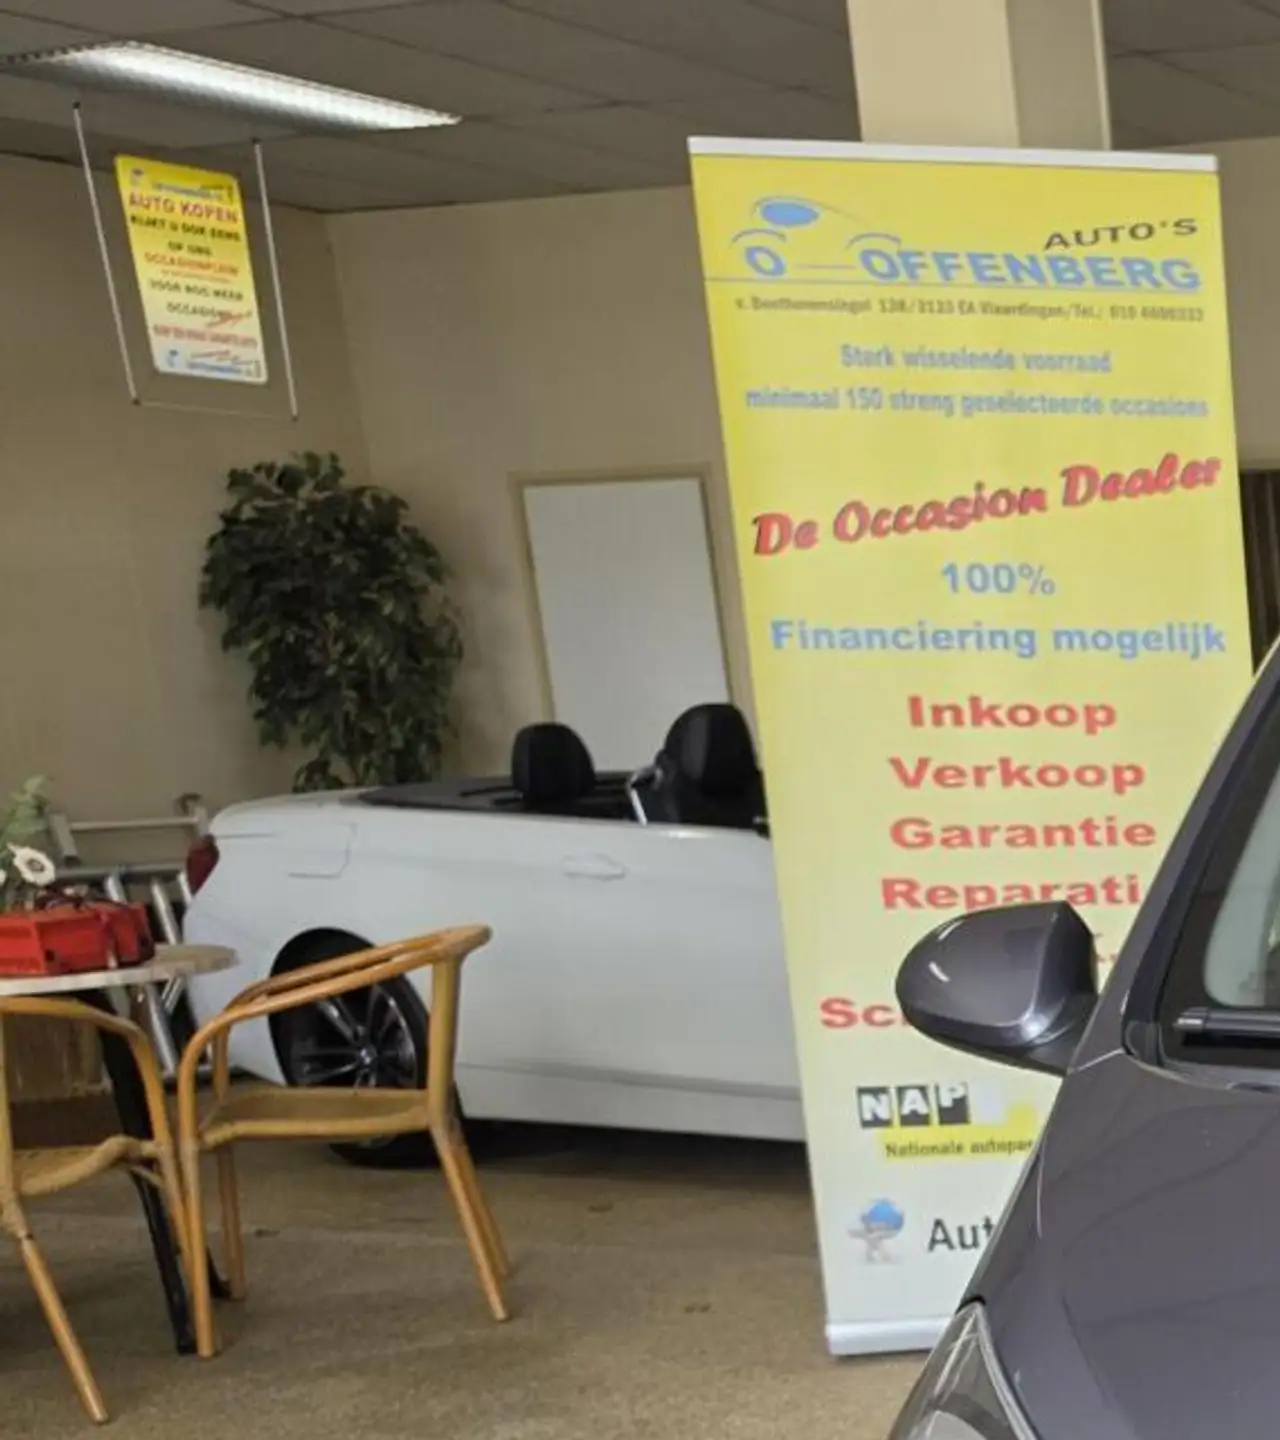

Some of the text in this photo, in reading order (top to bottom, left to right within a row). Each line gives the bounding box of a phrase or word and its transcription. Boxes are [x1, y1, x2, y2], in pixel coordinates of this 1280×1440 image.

[181, 200, 238, 224] KOPEN
[1045, 218, 1197, 250] AUTO'S
[859, 246, 1200, 290] OFFENBERG
[903, 346, 1015, 372] wisselende
[1024, 350, 1111, 374] voorraad
[745, 388, 840, 411] minimaal
[889, 391, 955, 418] streng
[961, 391, 1105, 419] geselecteerde
[1109, 396, 1209, 418] occasions
[752, 452, 1222, 557] De Occasion Dealer
[941, 562, 1057, 597] 100%
[770, 619, 1226, 660] Financiering mogelijk
[907, 695, 1117, 735] Inkoop
[888, 756, 1147, 795] Verkoop
[889, 815, 1157, 850] Garantie
[881, 873, 1141, 911] Reparati
[820, 996, 909, 1030] Sc
[858, 1082, 970, 1128] NAP
[886, 1141, 963, 1159] Nationale
[928, 1218, 996, 1253] Aut
